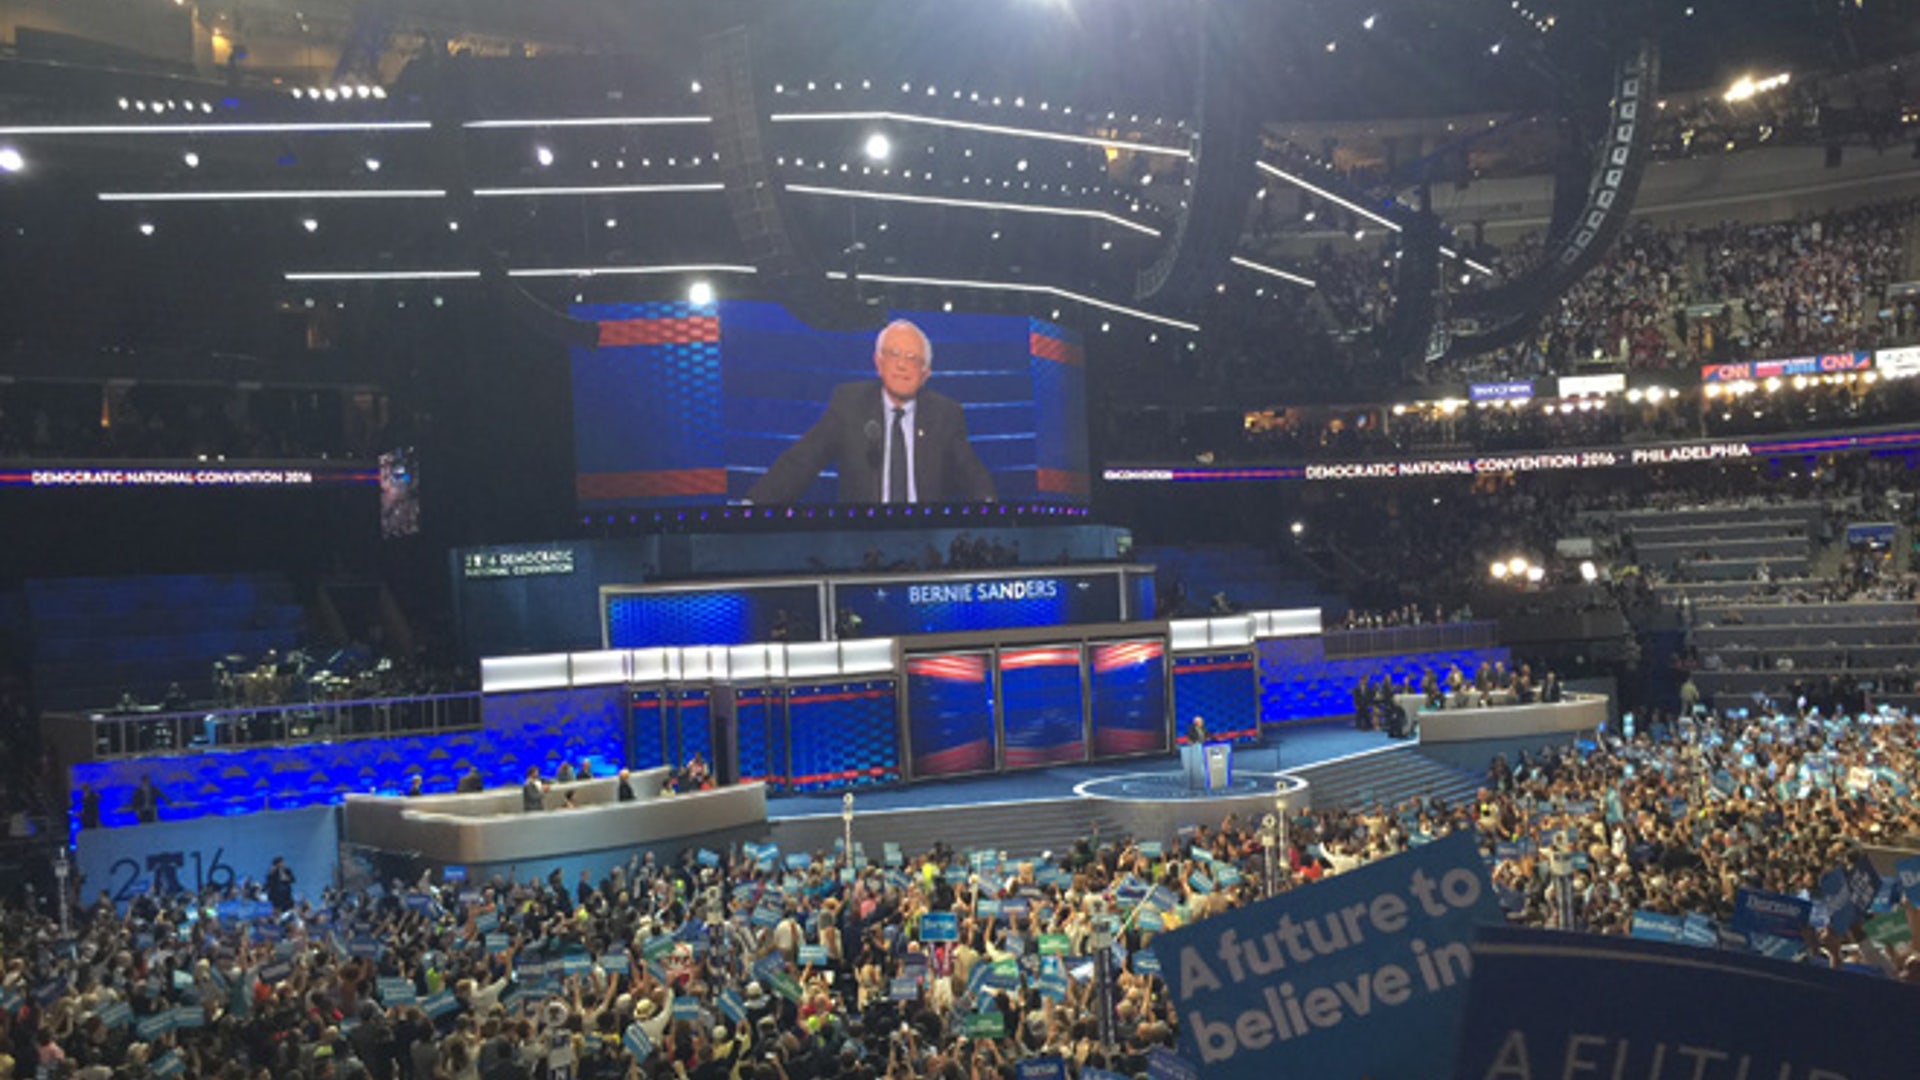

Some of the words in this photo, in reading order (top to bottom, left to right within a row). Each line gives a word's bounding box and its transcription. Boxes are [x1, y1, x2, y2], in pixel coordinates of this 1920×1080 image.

[1718, 363, 1750, 379] CNN
[1820, 353, 1854, 370] CNN
[1305, 463, 1397, 479] DEMOCRATIC
[1399, 459, 1473, 475] NATIONAL
[1474, 454, 1577, 471] CONVENTION
[1581, 453, 1616, 467] 2016
[1631, 443, 1751, 463] PHILADELPHIA
[31, 470, 124, 485] DEMOCRATIC
[126, 470, 194, 483] NATIONAL
[196, 470, 283, 484] CONVENTION
[284, 471, 312, 482] 2016
[500, 550, 573, 564] DEMOCRATIC
[512, 562, 574, 575] CONVENTION
[908, 583, 974, 603] BERNIE
[976, 580, 1057, 600] SANDERS
[1179, 946, 1222, 1000] A
[1216, 892, 1410, 984] future
[1410, 867, 1482, 918] to
[1187, 963, 1413, 1065] believe
[1411, 938, 1474, 993] in
[1561, 1032, 1852, 1080] FUT
